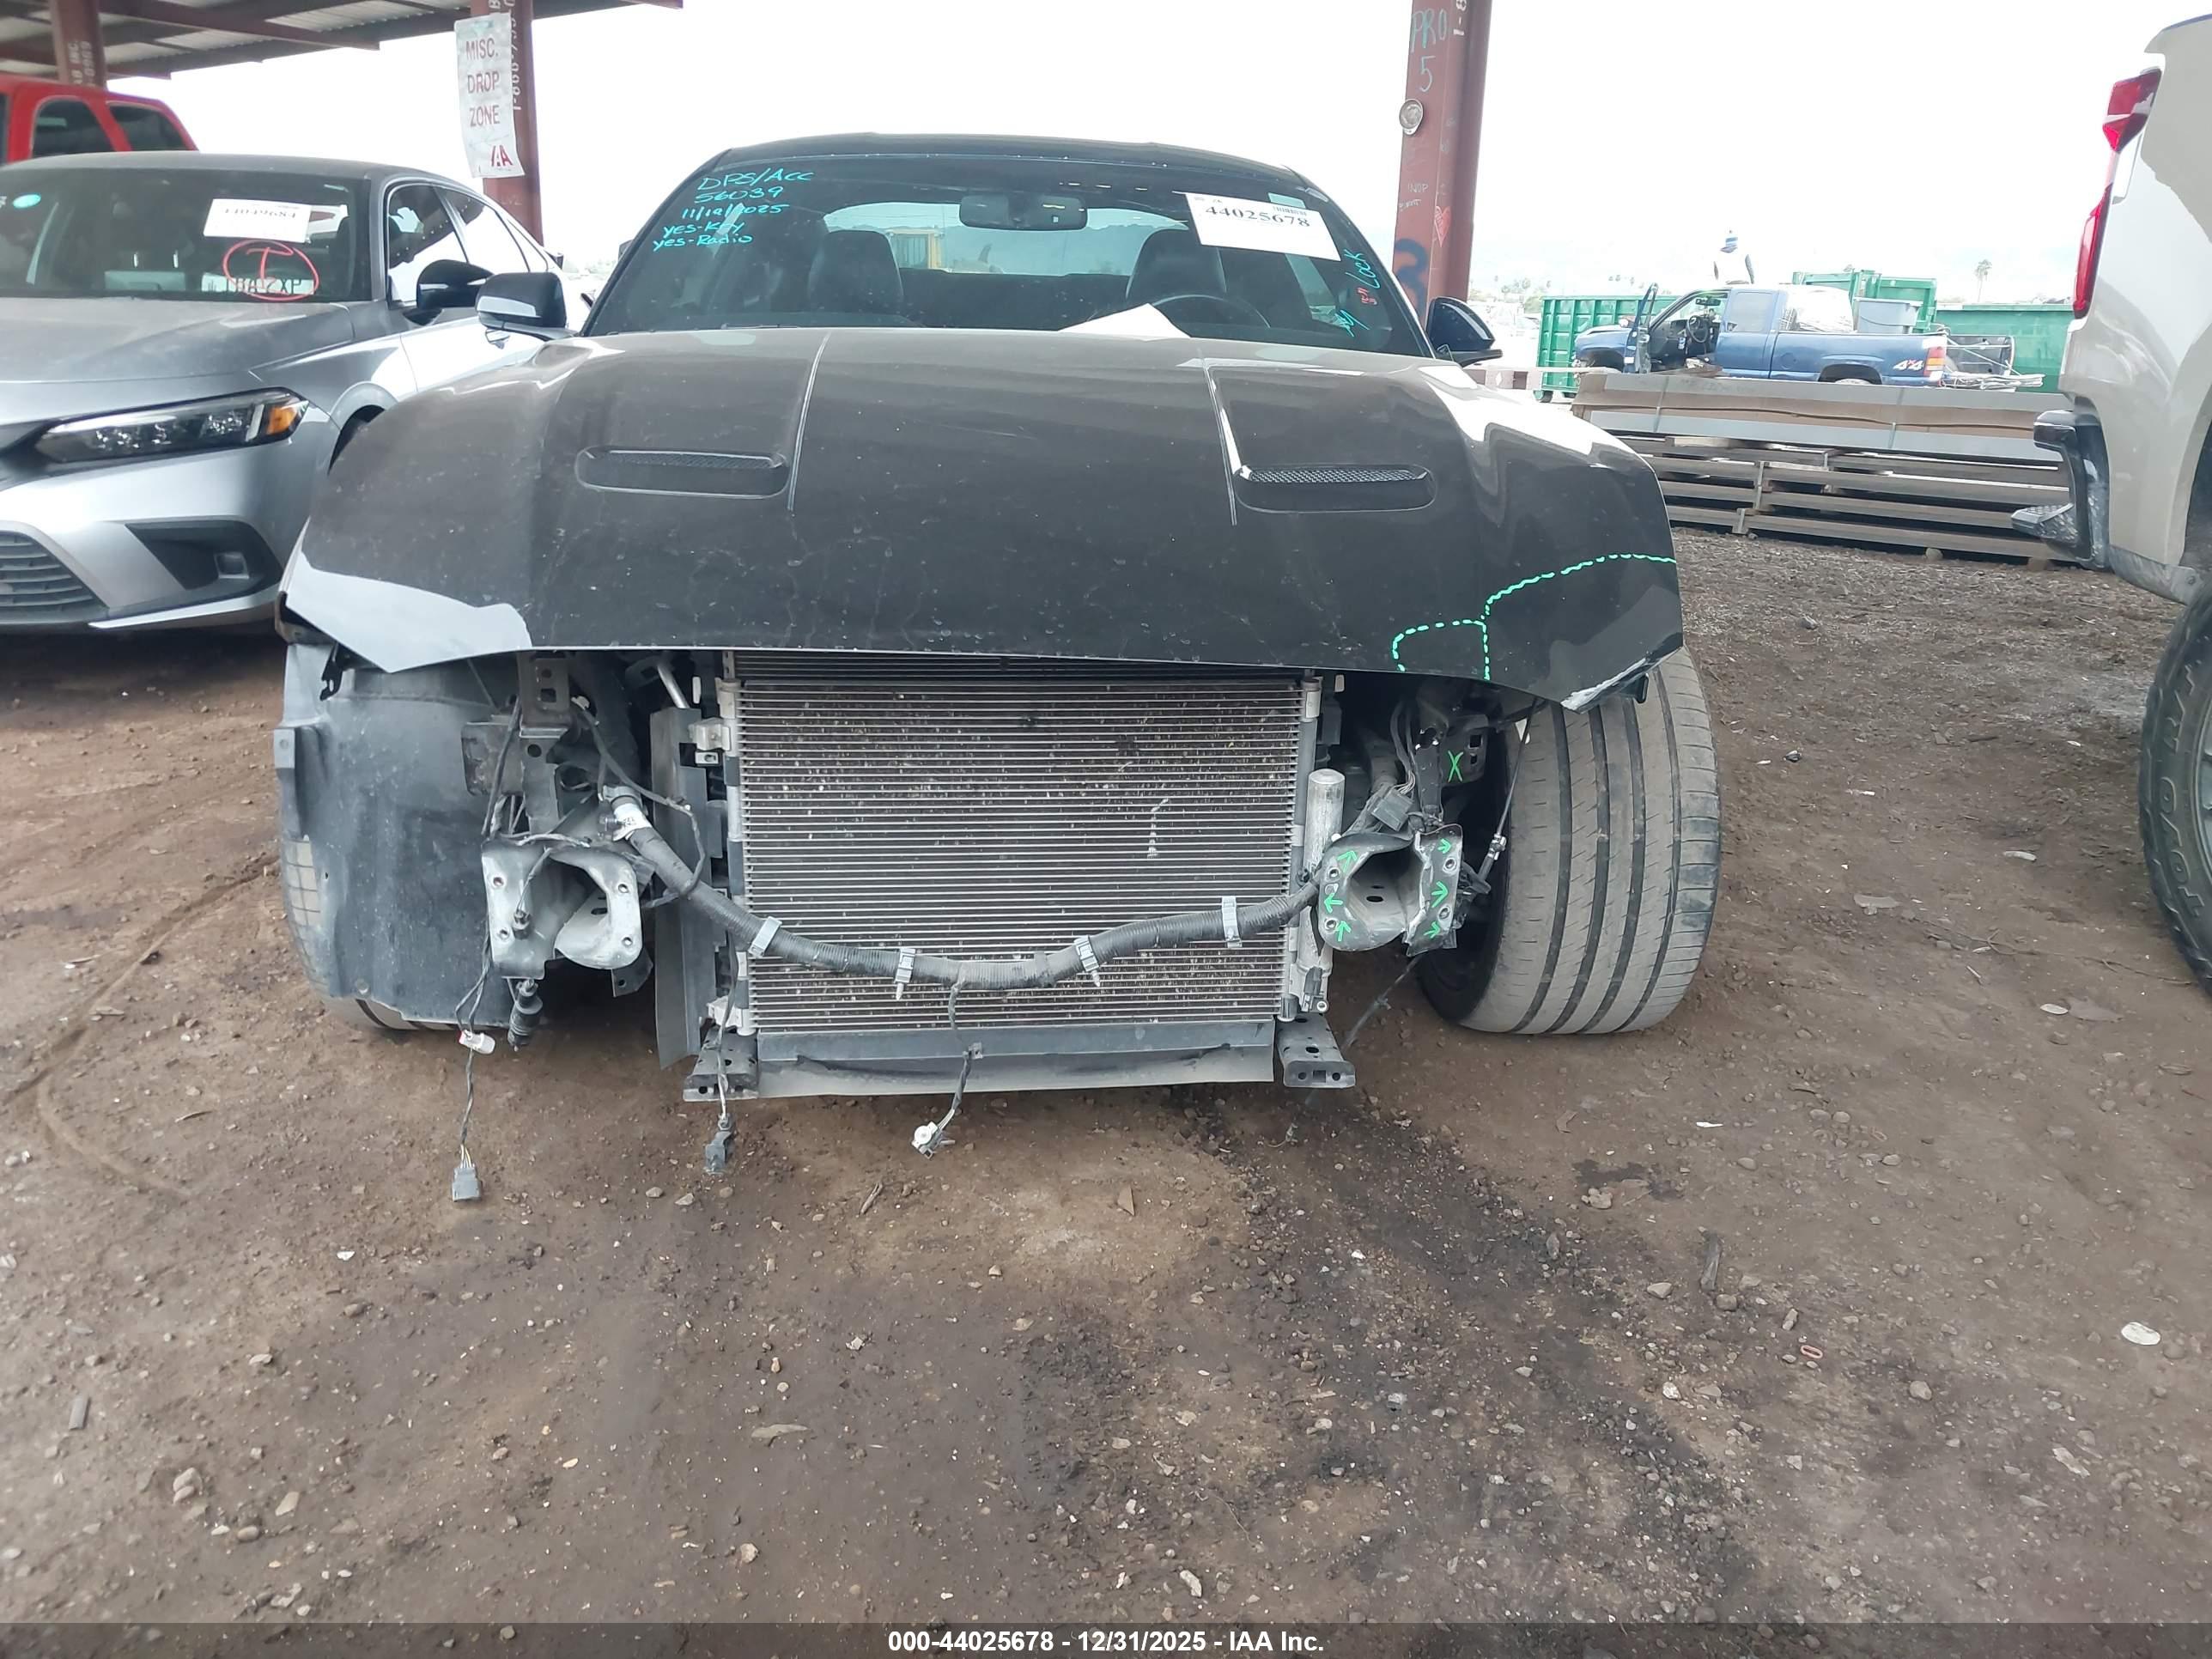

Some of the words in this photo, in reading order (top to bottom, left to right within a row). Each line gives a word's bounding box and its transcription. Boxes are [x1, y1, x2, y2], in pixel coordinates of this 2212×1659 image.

[465, 37, 499, 60] MISC.
[467, 70, 500, 94] DROP
[470, 105, 501, 127] ZONE
[694, 186, 783, 204] 56039
[1205, 206, 1310, 228] 44025678
